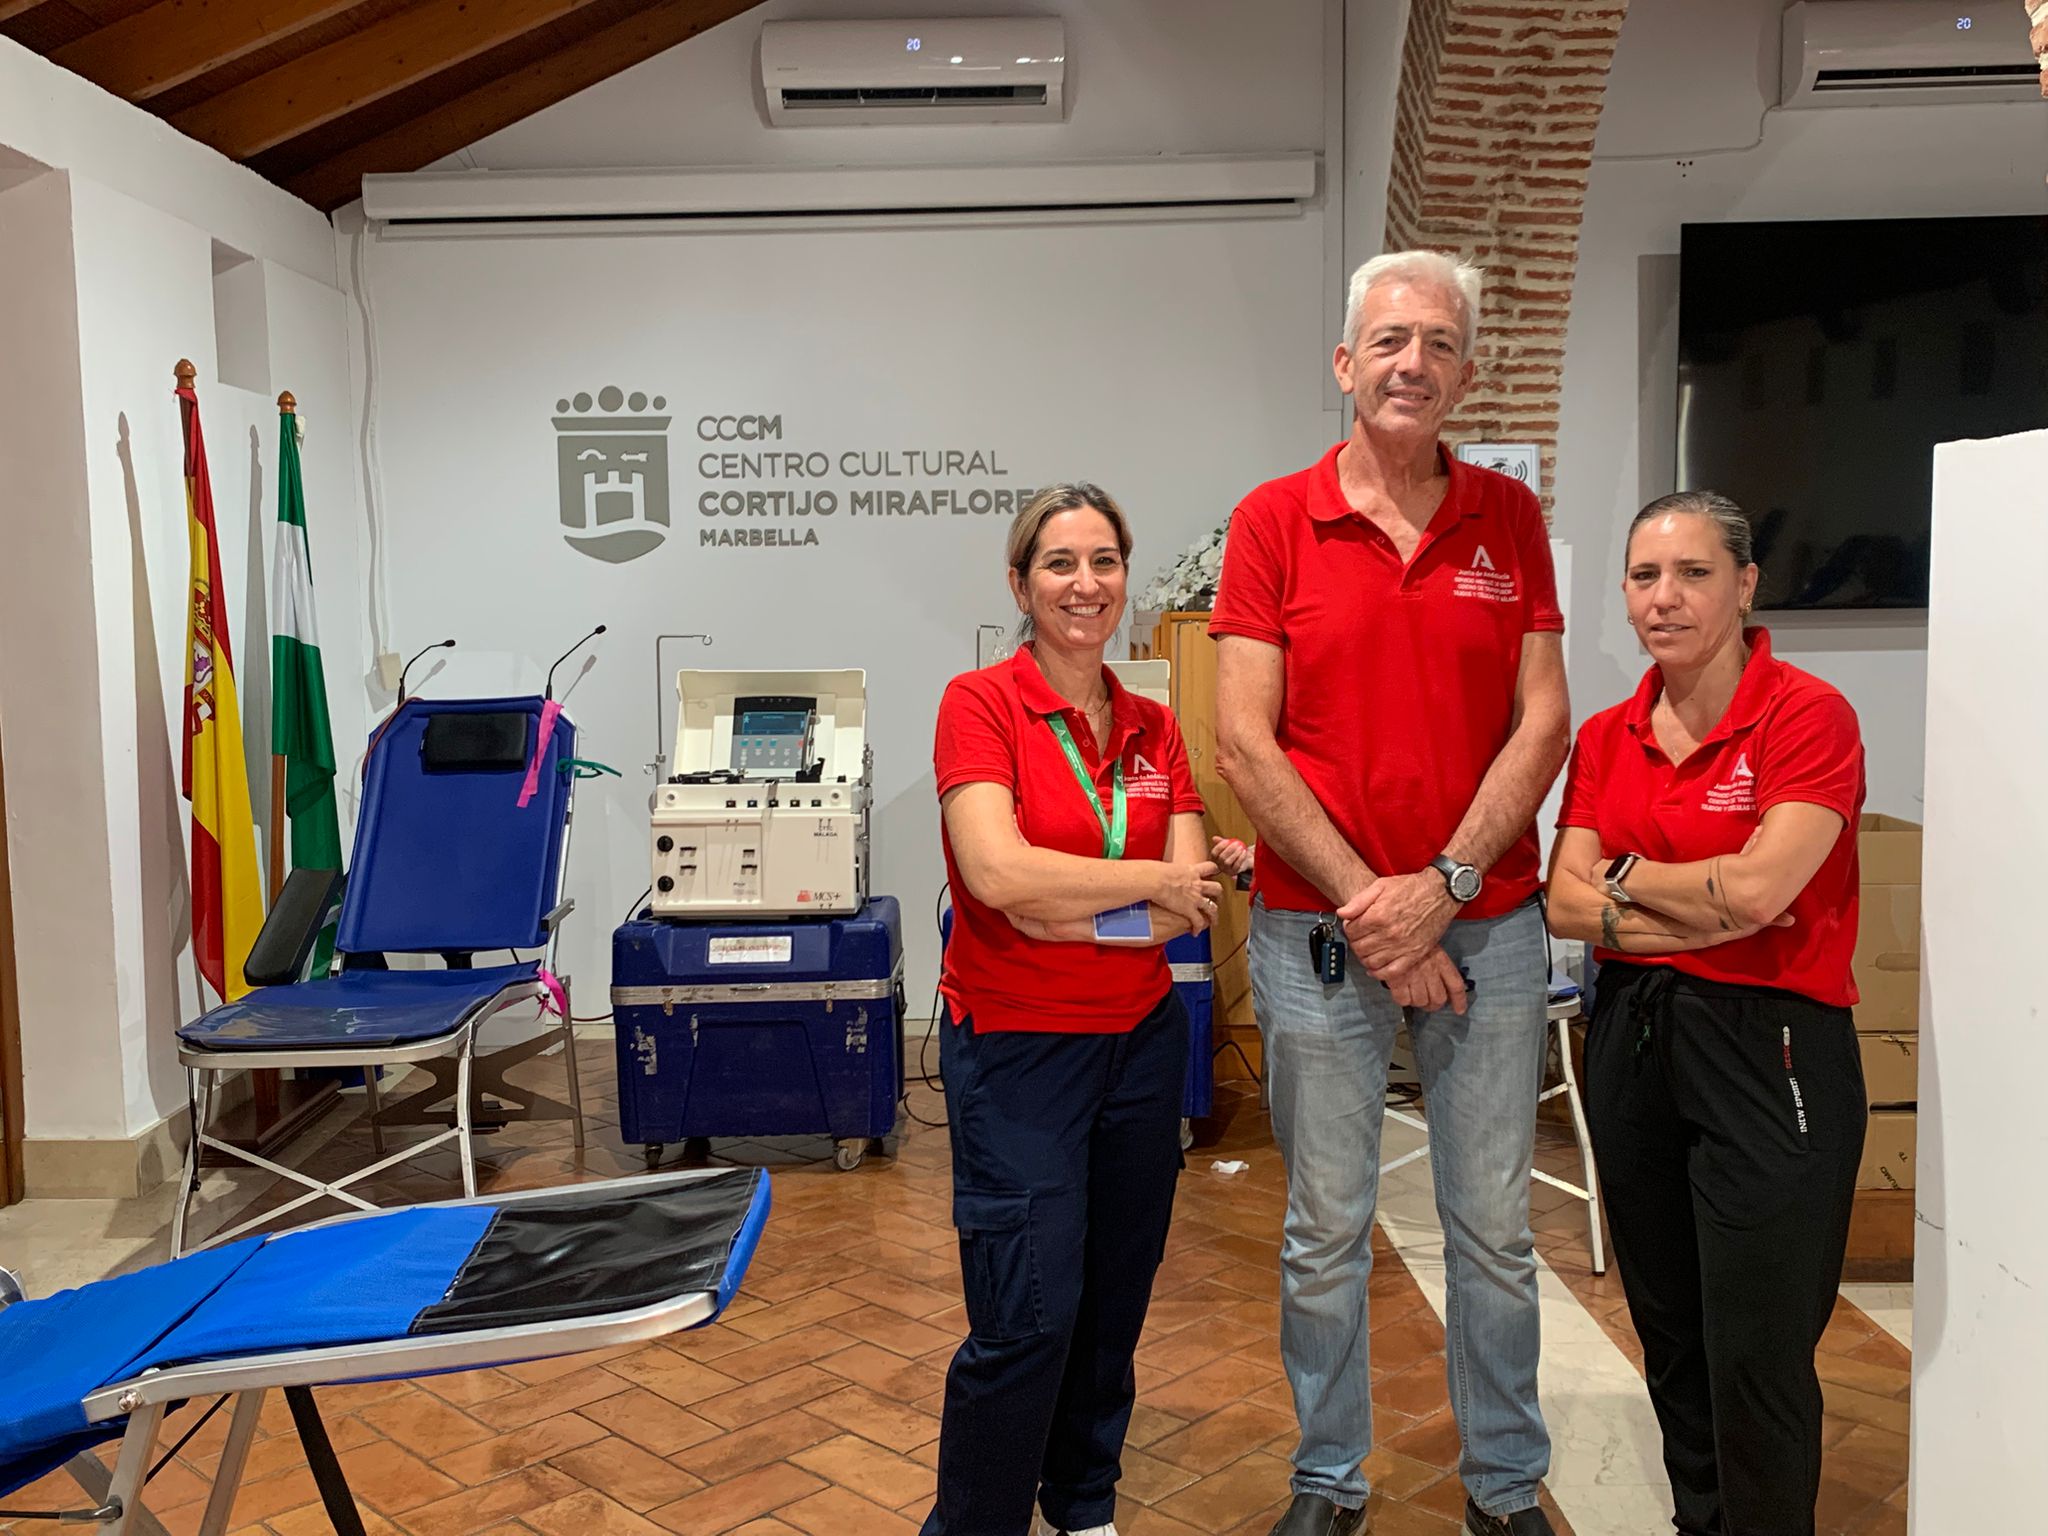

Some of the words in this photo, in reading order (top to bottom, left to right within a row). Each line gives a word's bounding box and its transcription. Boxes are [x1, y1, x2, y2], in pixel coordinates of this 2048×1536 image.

[1956, 17, 1971, 30] 20
[906, 38, 921, 51] 20
[697, 414, 783, 442] CCCM
[698, 452, 830, 479] CENTRO
[839, 450, 1008, 477] CULTURAL
[698, 490, 838, 517] CORTIJO
[850, 489, 1038, 516] MIRAFLORE
[699, 528, 820, 547] MARBELLA
